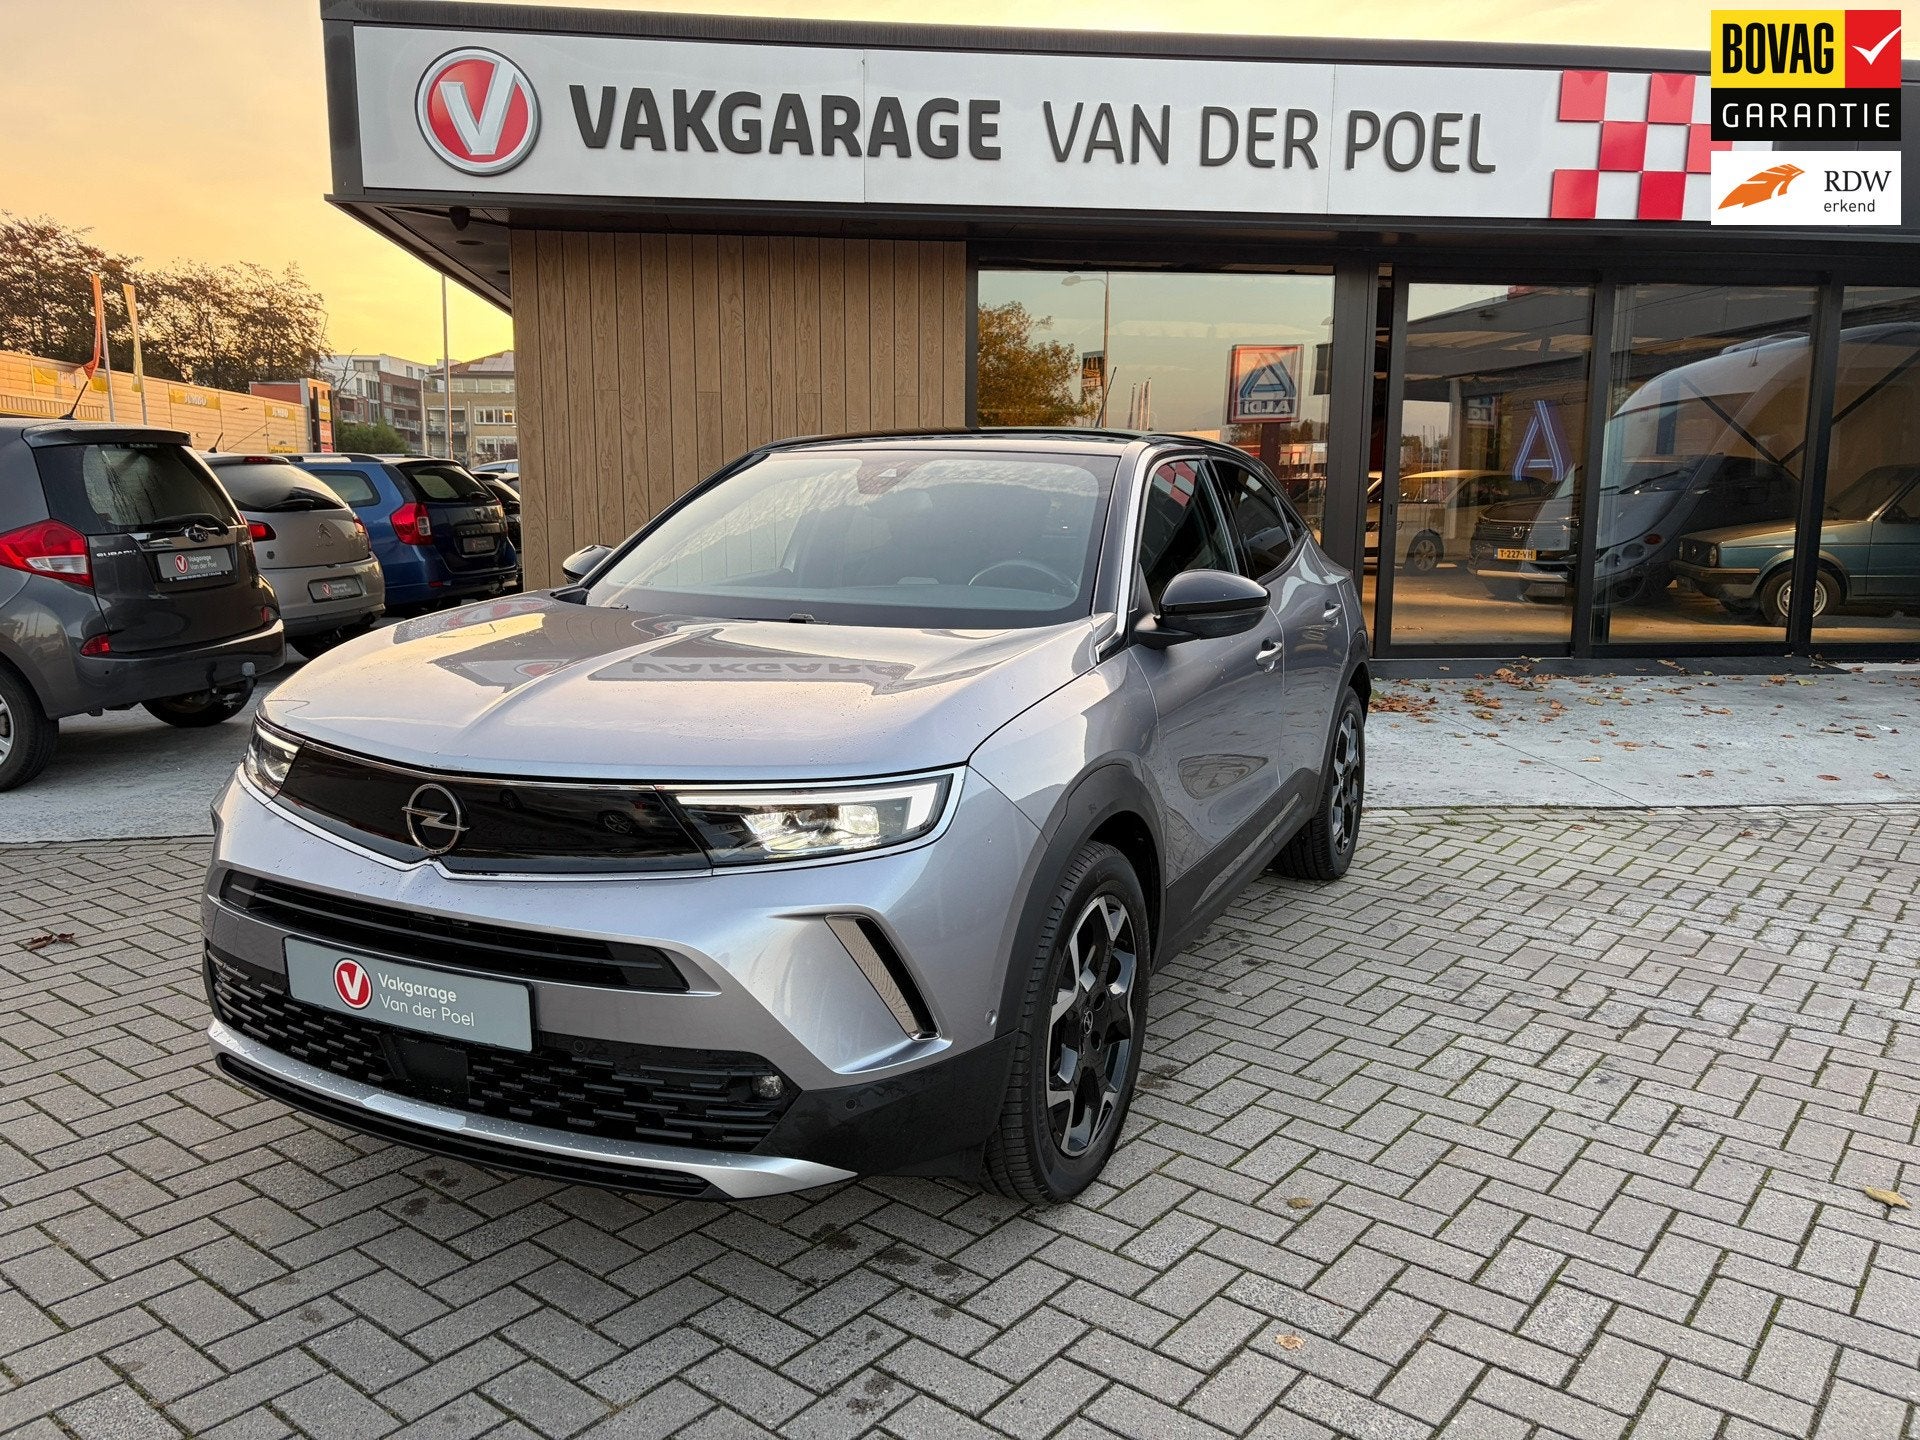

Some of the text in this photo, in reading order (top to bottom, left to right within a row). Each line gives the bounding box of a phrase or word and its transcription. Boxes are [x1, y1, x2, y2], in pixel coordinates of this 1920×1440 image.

[568, 84, 1496, 173] VAKGARAGE VAN DER POEL
[96, 549, 137, 558] SUBARU
[377, 972, 457, 1005] Vakgarage
[379, 993, 475, 1027] Van der Poel
